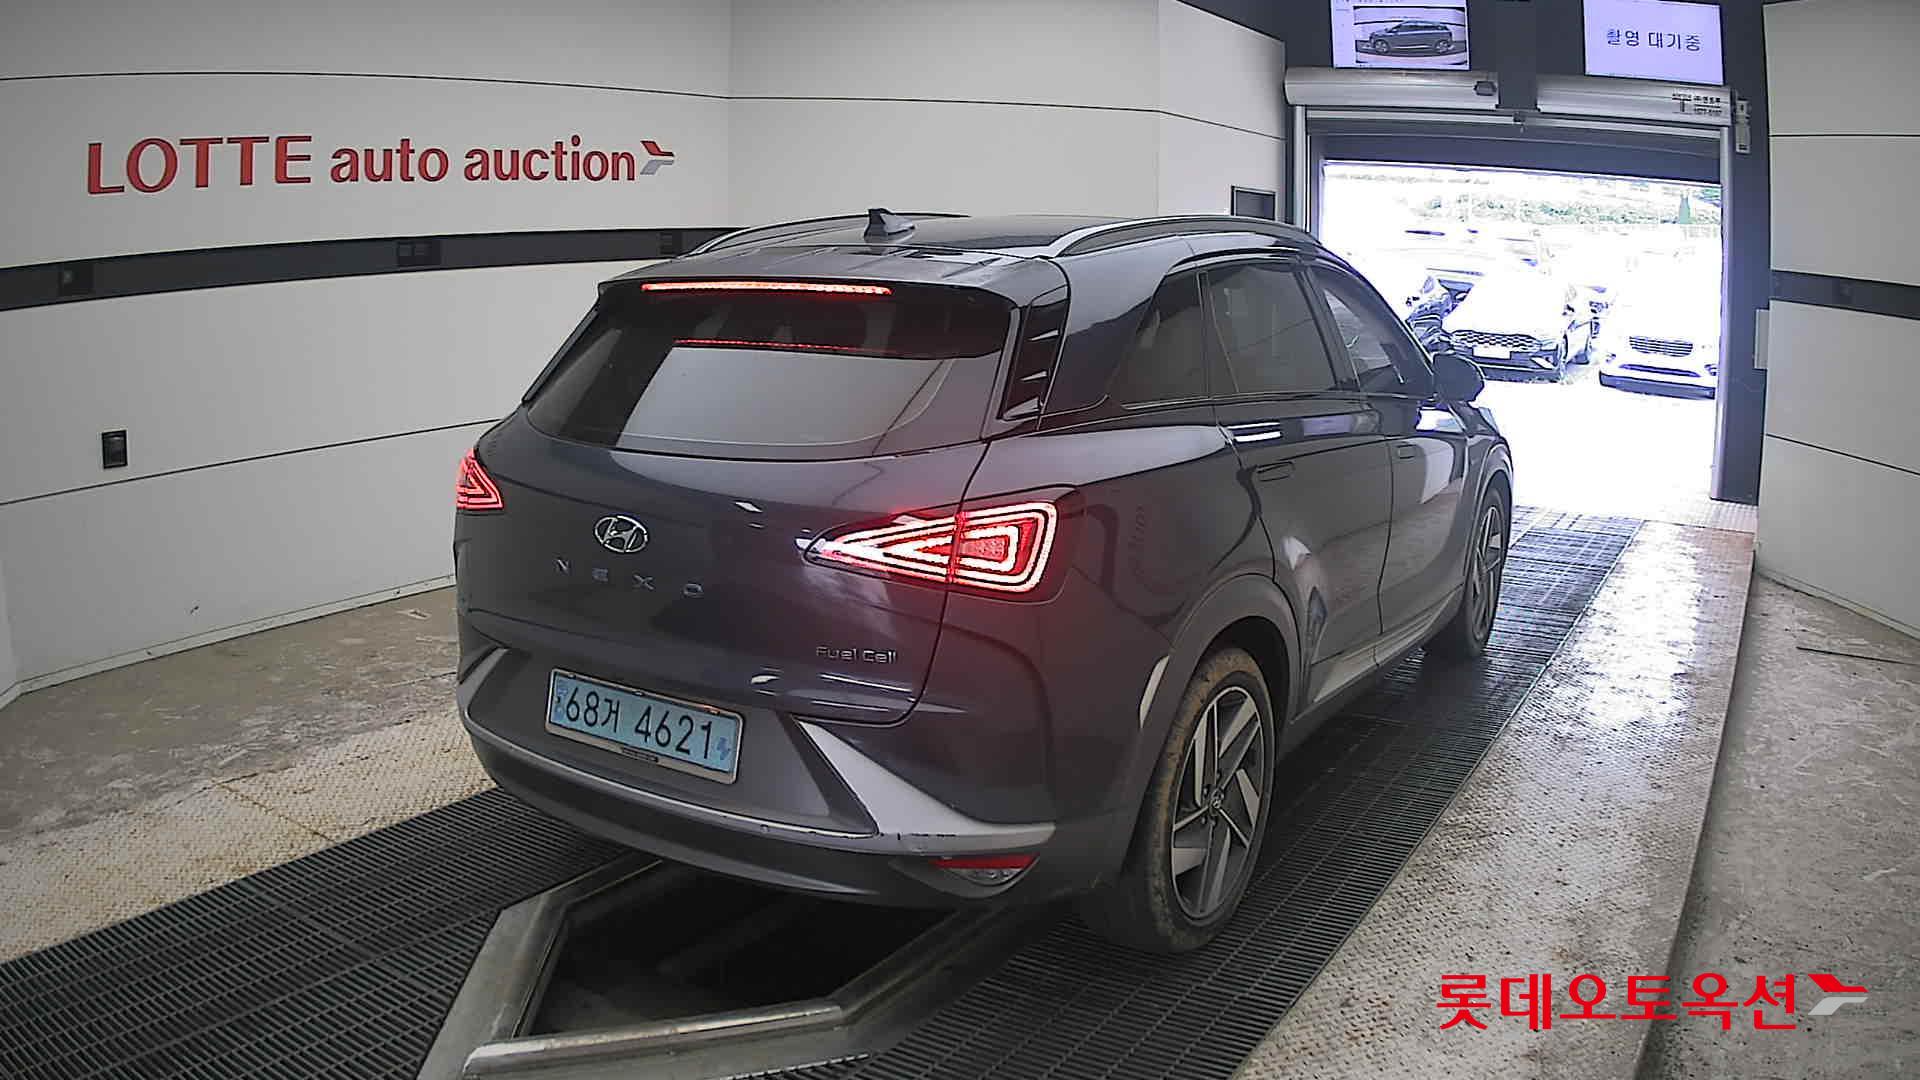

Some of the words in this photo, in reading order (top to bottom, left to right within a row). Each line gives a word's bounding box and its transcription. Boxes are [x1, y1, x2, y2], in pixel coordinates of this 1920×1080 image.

[1647, 31, 1701, 52] 대기중
[88, 135, 312, 195] LOTTE
[330, 138, 449, 183] auto
[464, 134, 636, 182] auction
[555, 558, 704, 598] NEXO
[816, 646, 857, 661] Fuel
[863, 649, 897, 664] Cell
[566, 687, 620, 733] 68거
[634, 706, 713, 760] 4621
